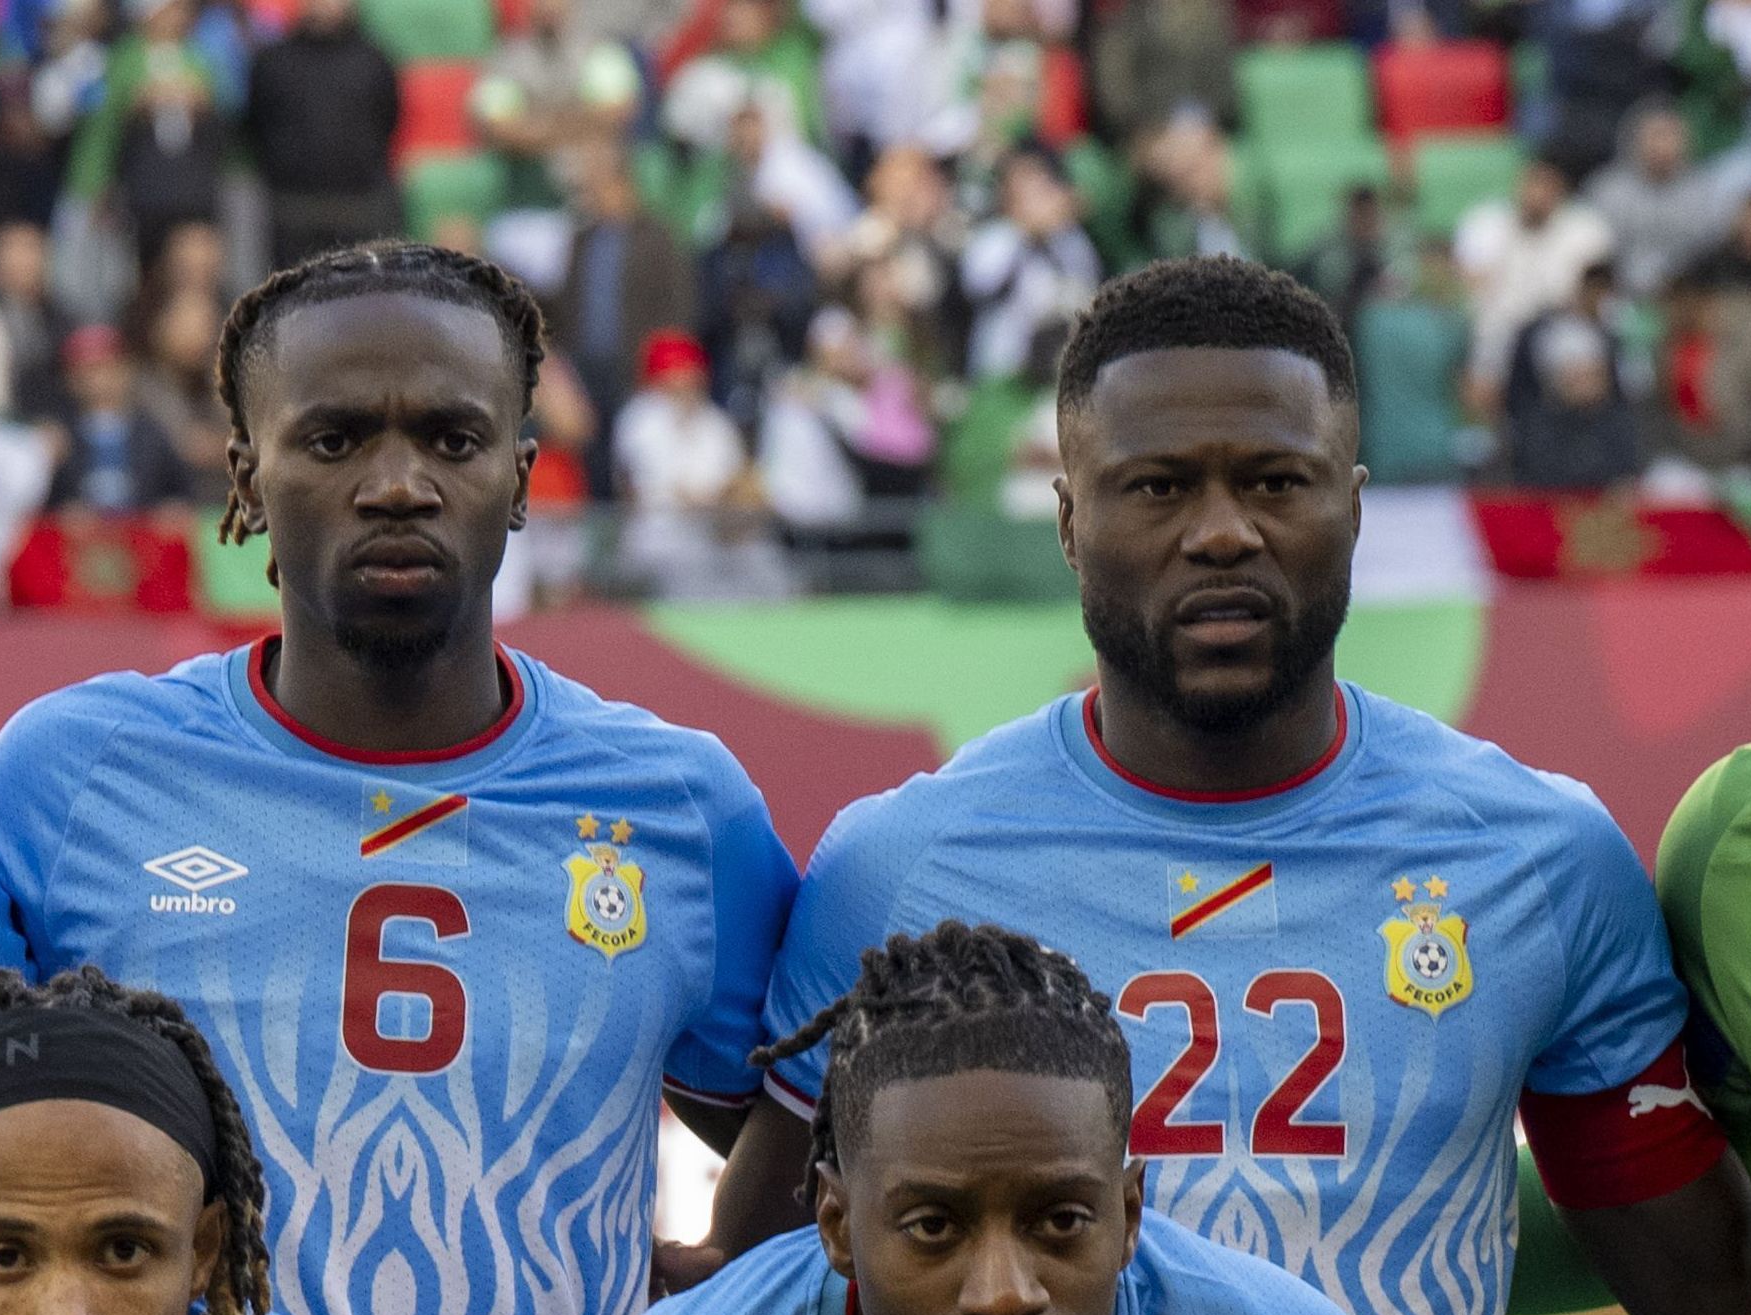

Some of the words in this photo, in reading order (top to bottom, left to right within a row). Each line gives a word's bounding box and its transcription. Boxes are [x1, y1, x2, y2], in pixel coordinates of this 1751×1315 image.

[150, 893, 236, 914] umbro
[583, 921, 636, 945] FECOFA
[340, 881, 471, 1074] 6
[1404, 982, 1463, 1003] FECOFA
[1115, 968, 1347, 1159] 22
